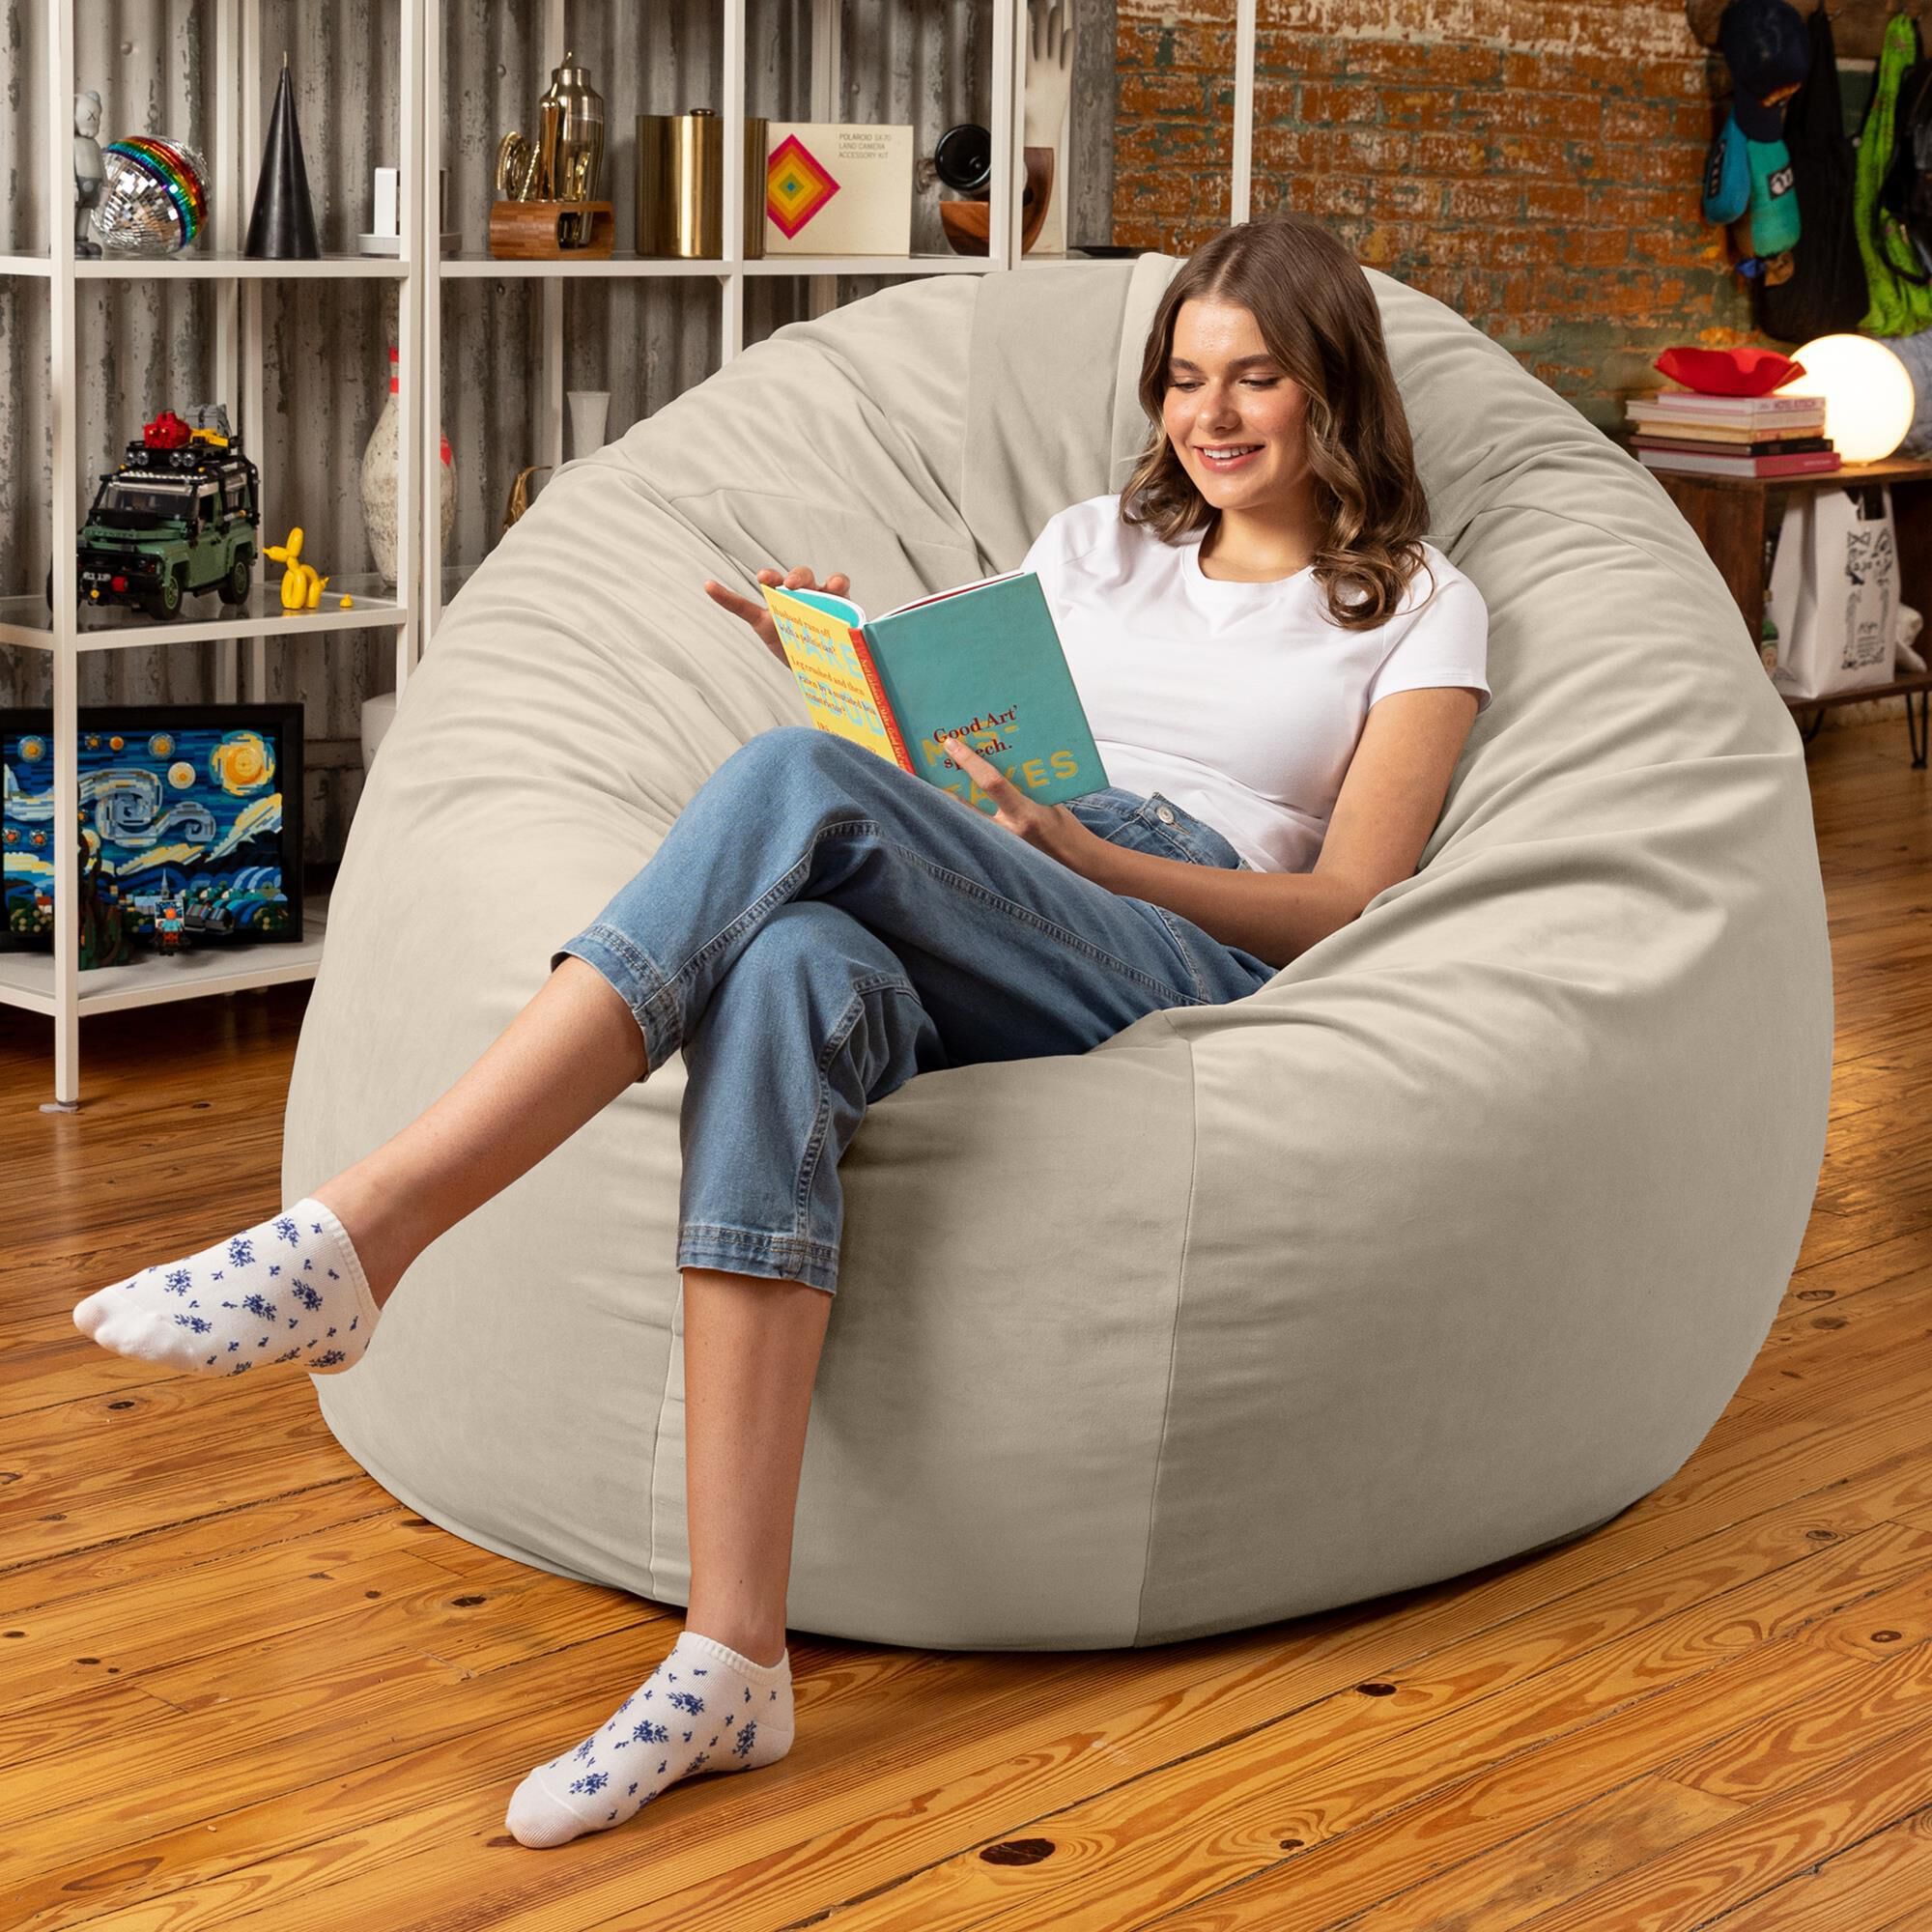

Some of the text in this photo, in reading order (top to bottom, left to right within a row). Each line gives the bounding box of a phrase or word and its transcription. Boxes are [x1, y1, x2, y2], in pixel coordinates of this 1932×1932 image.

[838, 132, 873, 141] POLAROID
[838, 142, 886, 151] LAND CAMERA
[838, 151, 877, 159] ACCESSORY
[933, 704, 1018, 744] Good Art'
[943, 738, 1013, 771] sech.
